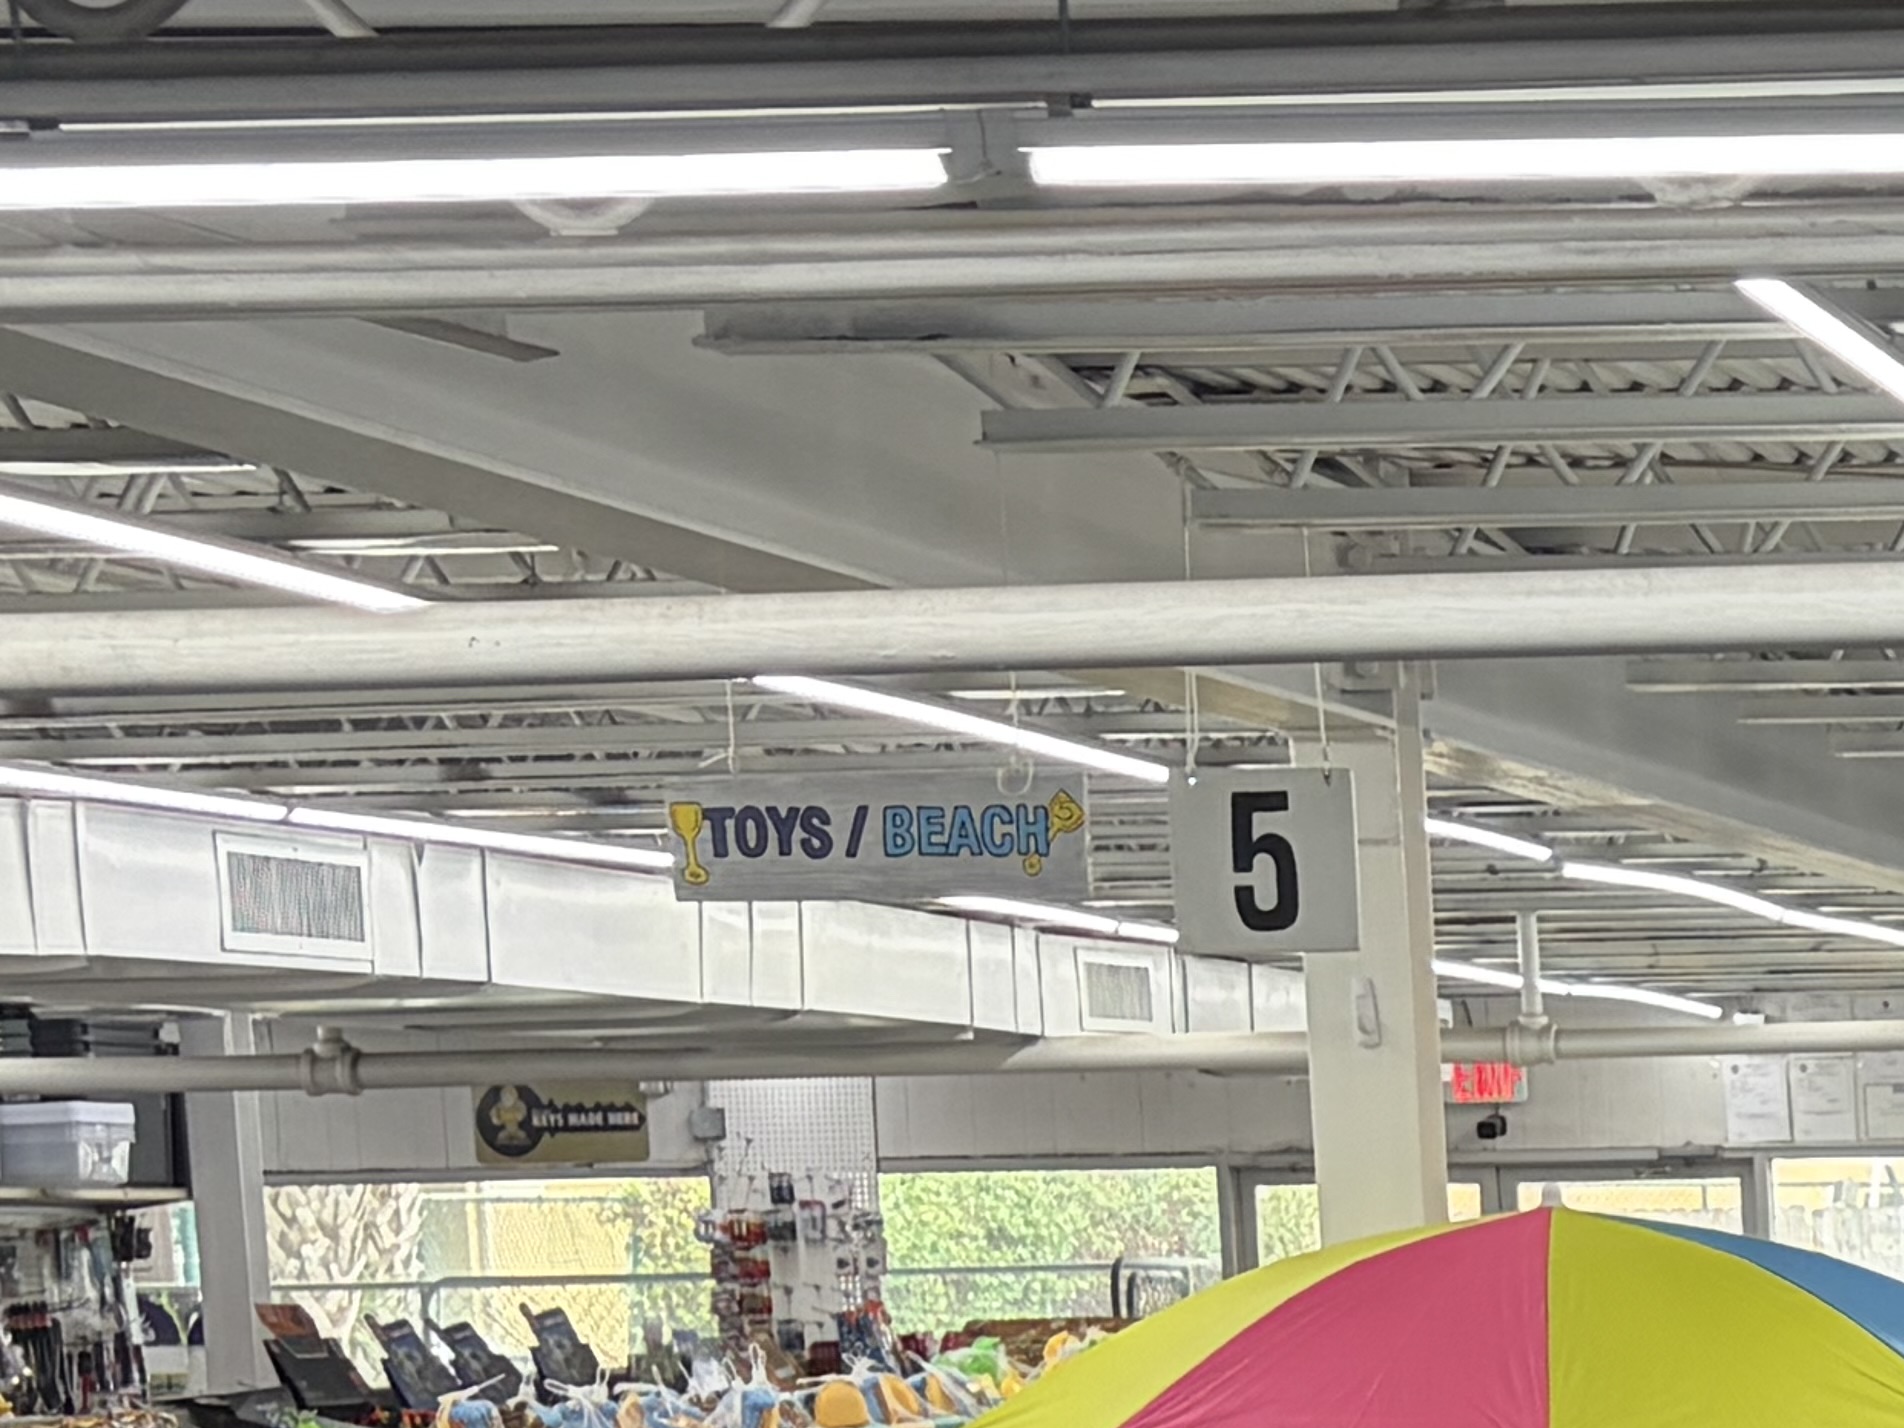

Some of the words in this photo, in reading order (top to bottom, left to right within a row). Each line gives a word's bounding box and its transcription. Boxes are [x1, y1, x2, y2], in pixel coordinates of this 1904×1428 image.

[702, 805, 833, 858] TOYS
[883, 803, 1050, 858] BEACH
[1230, 790, 1301, 933] 5
[568, 1110, 604, 1127] MADE
[607, 1110, 641, 1126] HERE
